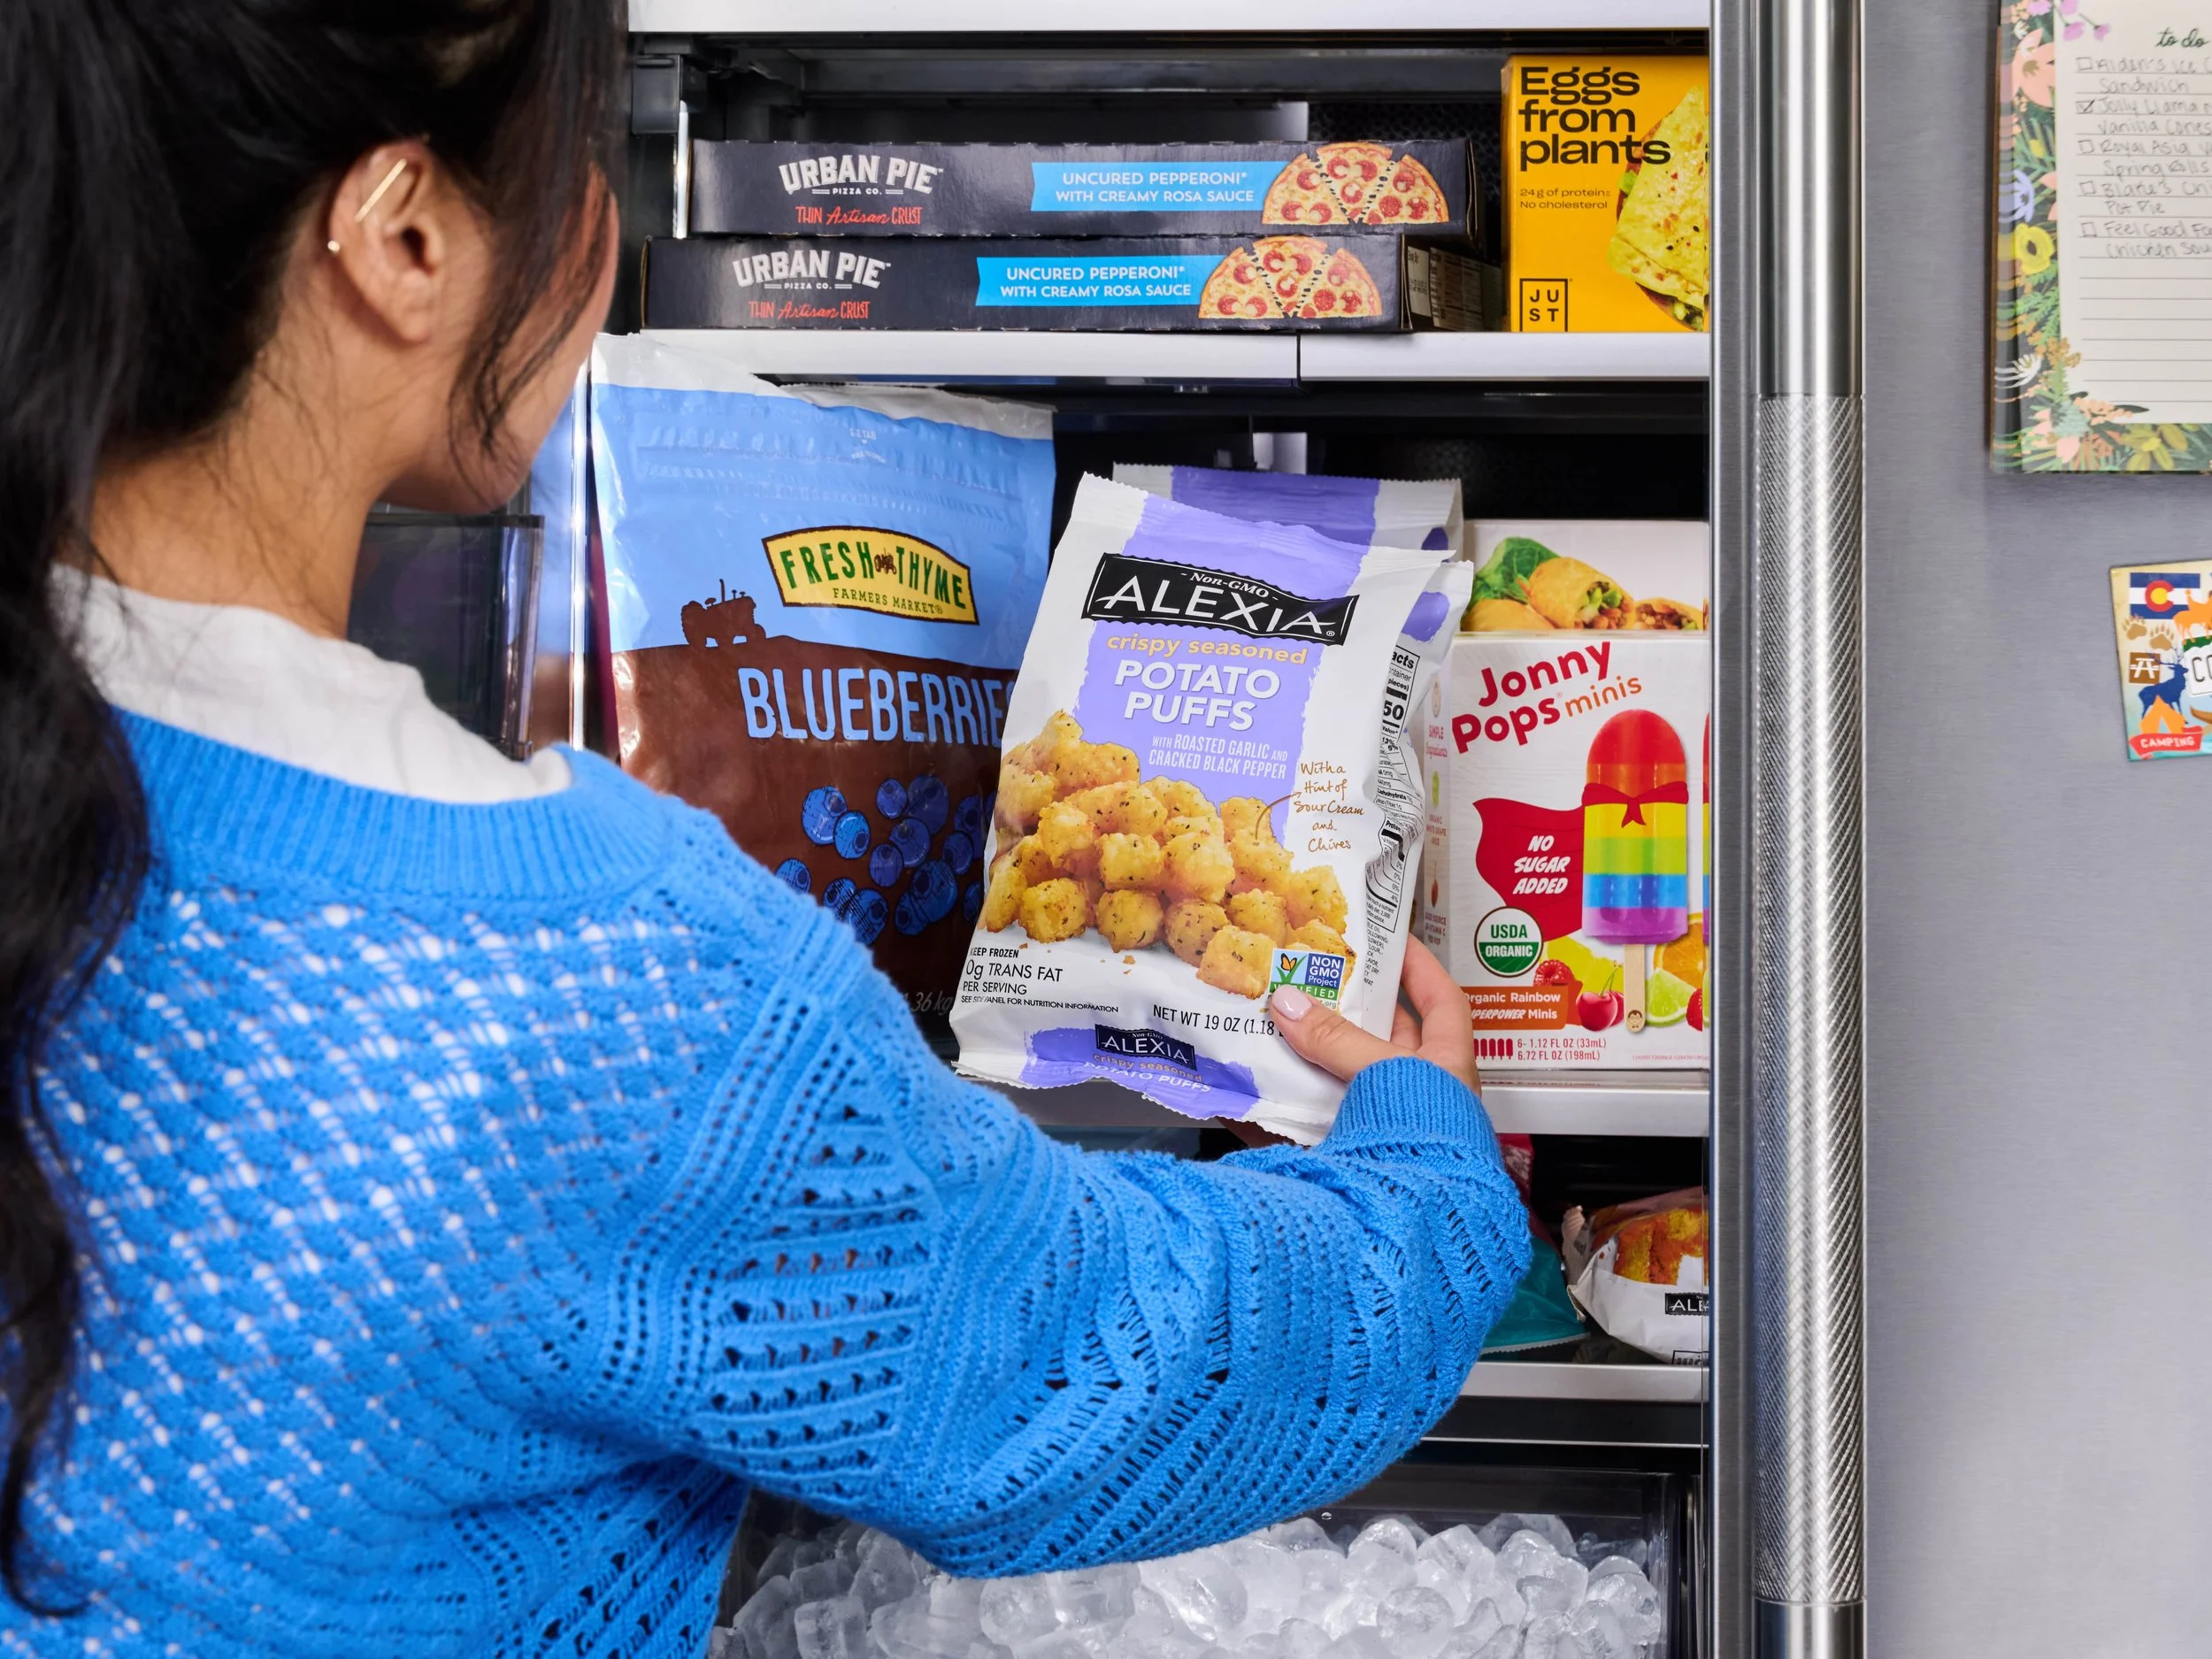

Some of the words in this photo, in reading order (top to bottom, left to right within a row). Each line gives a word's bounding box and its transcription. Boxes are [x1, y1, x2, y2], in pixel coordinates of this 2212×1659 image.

[2155, 27, 2177, 47] to
[2181, 28, 2209, 48] do
[1521, 66, 1640, 105] Eggs
[1518, 98, 1636, 133] from
[1520, 134, 1671, 172] plants
[779, 155, 880, 195] URBAN
[1063, 172, 1143, 185] UNCURED
[1056, 190, 1093, 202] WITH
[1098, 190, 1158, 202] CREAMY
[1164, 190, 1202, 202] ROSA
[1207, 190, 1254, 202] SAUCE
[795, 206, 823, 224] THIN
[826, 206, 888, 225] Artisan
[891, 206, 922, 225] CRUST
[2143, 219, 2188, 237] Good
[733, 250, 831, 288] URBAN
[1006, 267, 1084, 280] UNCURED
[1001, 286, 1036, 297] WITH
[1041, 286, 1099, 297] CREAMY
[1104, 285, 1141, 296] ROSA
[1146, 284, 1191, 296] SAUCE
[749, 301, 775, 319] THIN
[778, 301, 840, 320] Artisan
[841, 301, 871, 319] CRUST
[780, 541, 874, 589] FRESH
[895, 545, 966, 609] THYME
[1190, 572, 1269, 598] Non-GMO
[833, 588, 887, 605] FARMERS
[1107, 633, 1181, 658] crispy
[1187, 638, 1309, 665] seasoned
[1392, 650, 1414, 670] acts
[1114, 659, 1281, 699] POTATO
[1479, 641, 1610, 707] Jonny
[1564, 676, 1642, 718] minis
[738, 667, 1014, 749] BLUEBERRIE
[1124, 691, 1257, 732] PUFFS
[1152, 736, 1171, 748] WITH
[1174, 733, 1226, 754] ROASTED
[1228, 741, 1270, 759] GARLIC
[1271, 750, 1288, 762] AND
[2140, 735, 2195, 749] CAMPING
[1148, 749, 1202, 769] CRACKED
[1203, 755, 1240, 774] BLACK
[1242, 760, 1286, 780] PEPPER
[1301, 761, 1335, 775] With
[1303, 780, 1333, 794] Hint
[1334, 779, 1348, 801] of
[1294, 800, 1327, 814] Sour
[1327, 800, 1364, 815] Cream
[1308, 838, 1351, 852] Chives
[1527, 836, 1555, 852] NO
[1513, 856, 1571, 873] SUGAR
[1512, 878, 1568, 895] ADDED
[1490, 924, 1528, 939] USDA
[970, 948, 987, 956] KEEP
[988, 948, 1019, 958] FROZEN
[1486, 945, 1533, 957] ORGANIC
[966, 958, 984, 979] 0g
[988, 963, 1033, 979] TRANS
[1037, 966, 1064, 982] FAT
[1311, 956, 1340, 969] NON
[1309, 975, 1337, 987] Project
[1310, 966, 1340, 979] GMO
[963, 981, 979, 992] PER
[982, 981, 1027, 995] SERVING
[1510, 992, 1561, 1002] Rainbow
[961, 995, 972, 1003] SEE
[1024, 999, 1063, 1009] NUTRITION
[1064, 1002, 1119, 1012] INFORMATION
[1153, 1004, 1178, 1023] NET
[1180, 1010, 1201, 1027] WT
[1204, 1014, 1218, 1031] 19
[1223, 1016, 1240, 1033] OZ
[1243, 1018, 1275, 1036] (1.18
[1528, 1009, 1557, 1019] Minis
[1101, 1035, 1189, 1064] ALEXIA
[1530, 1039, 1548, 1048] 1.12
[1550, 1038, 1560, 1048] FL
[1563, 1038, 1574, 1048] OZ
[1576, 1038, 1606, 1048] (33mL)
[1517, 1050, 1536, 1061] 6.72
[1539, 1050, 1548, 1060] FL
[1551, 1050, 1563, 1060] OZ
[1565, 1050, 1601, 1061] (198mL)
[1094, 1054, 1134, 1070] crispy
[1139, 1061, 1203, 1082] seasoned
